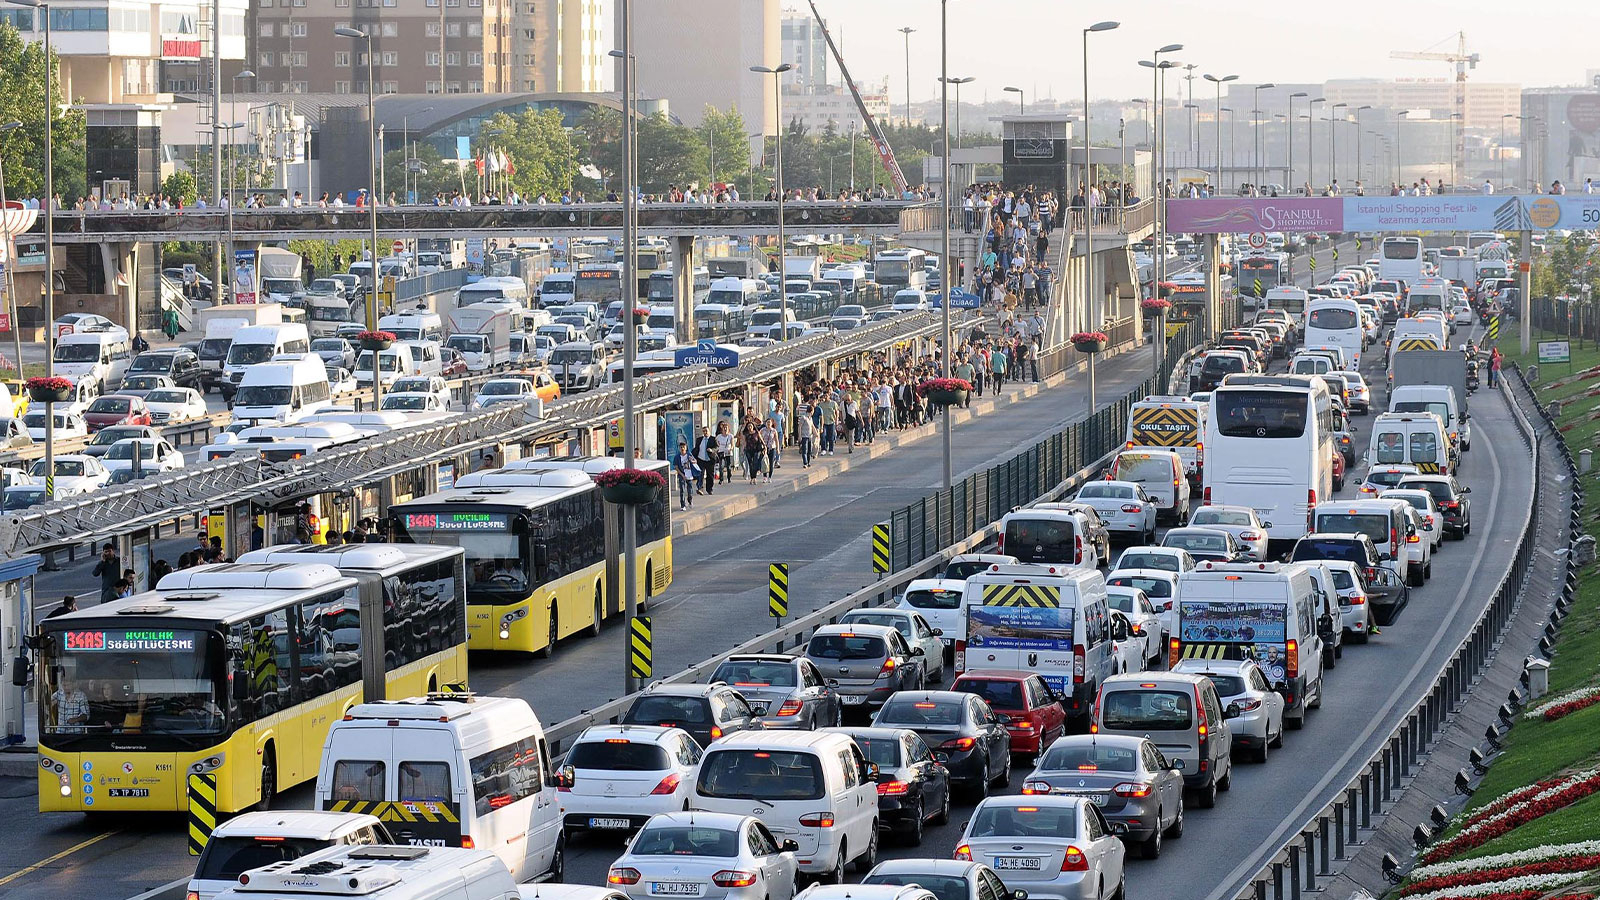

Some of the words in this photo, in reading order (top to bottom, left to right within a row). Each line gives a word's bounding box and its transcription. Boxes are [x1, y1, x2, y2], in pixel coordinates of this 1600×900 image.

[1357, 203, 1393, 213] İstanbul
[1396, 203, 1440, 215] Shopping
[1443, 203, 1464, 213] Fest
[1466, 203, 1477, 213] ile
[1378, 214, 1420, 224] kazanma
[1421, 214, 1457, 224] zamanı!
[1252, 236, 1263, 244] 80
[939, 298, 974, 306] CİZLİBAĞ
[1165, 424, 1191, 432] TAŞITI
[66, 631, 105, 649] 34AS
[593, 818, 602, 826] 34
[999, 858, 1008, 868] 34
[1011, 858, 1020, 868] HE
[1021, 857, 1039, 868] 4090
[656, 883, 666, 893] 34
[668, 883, 677, 893] HJ
